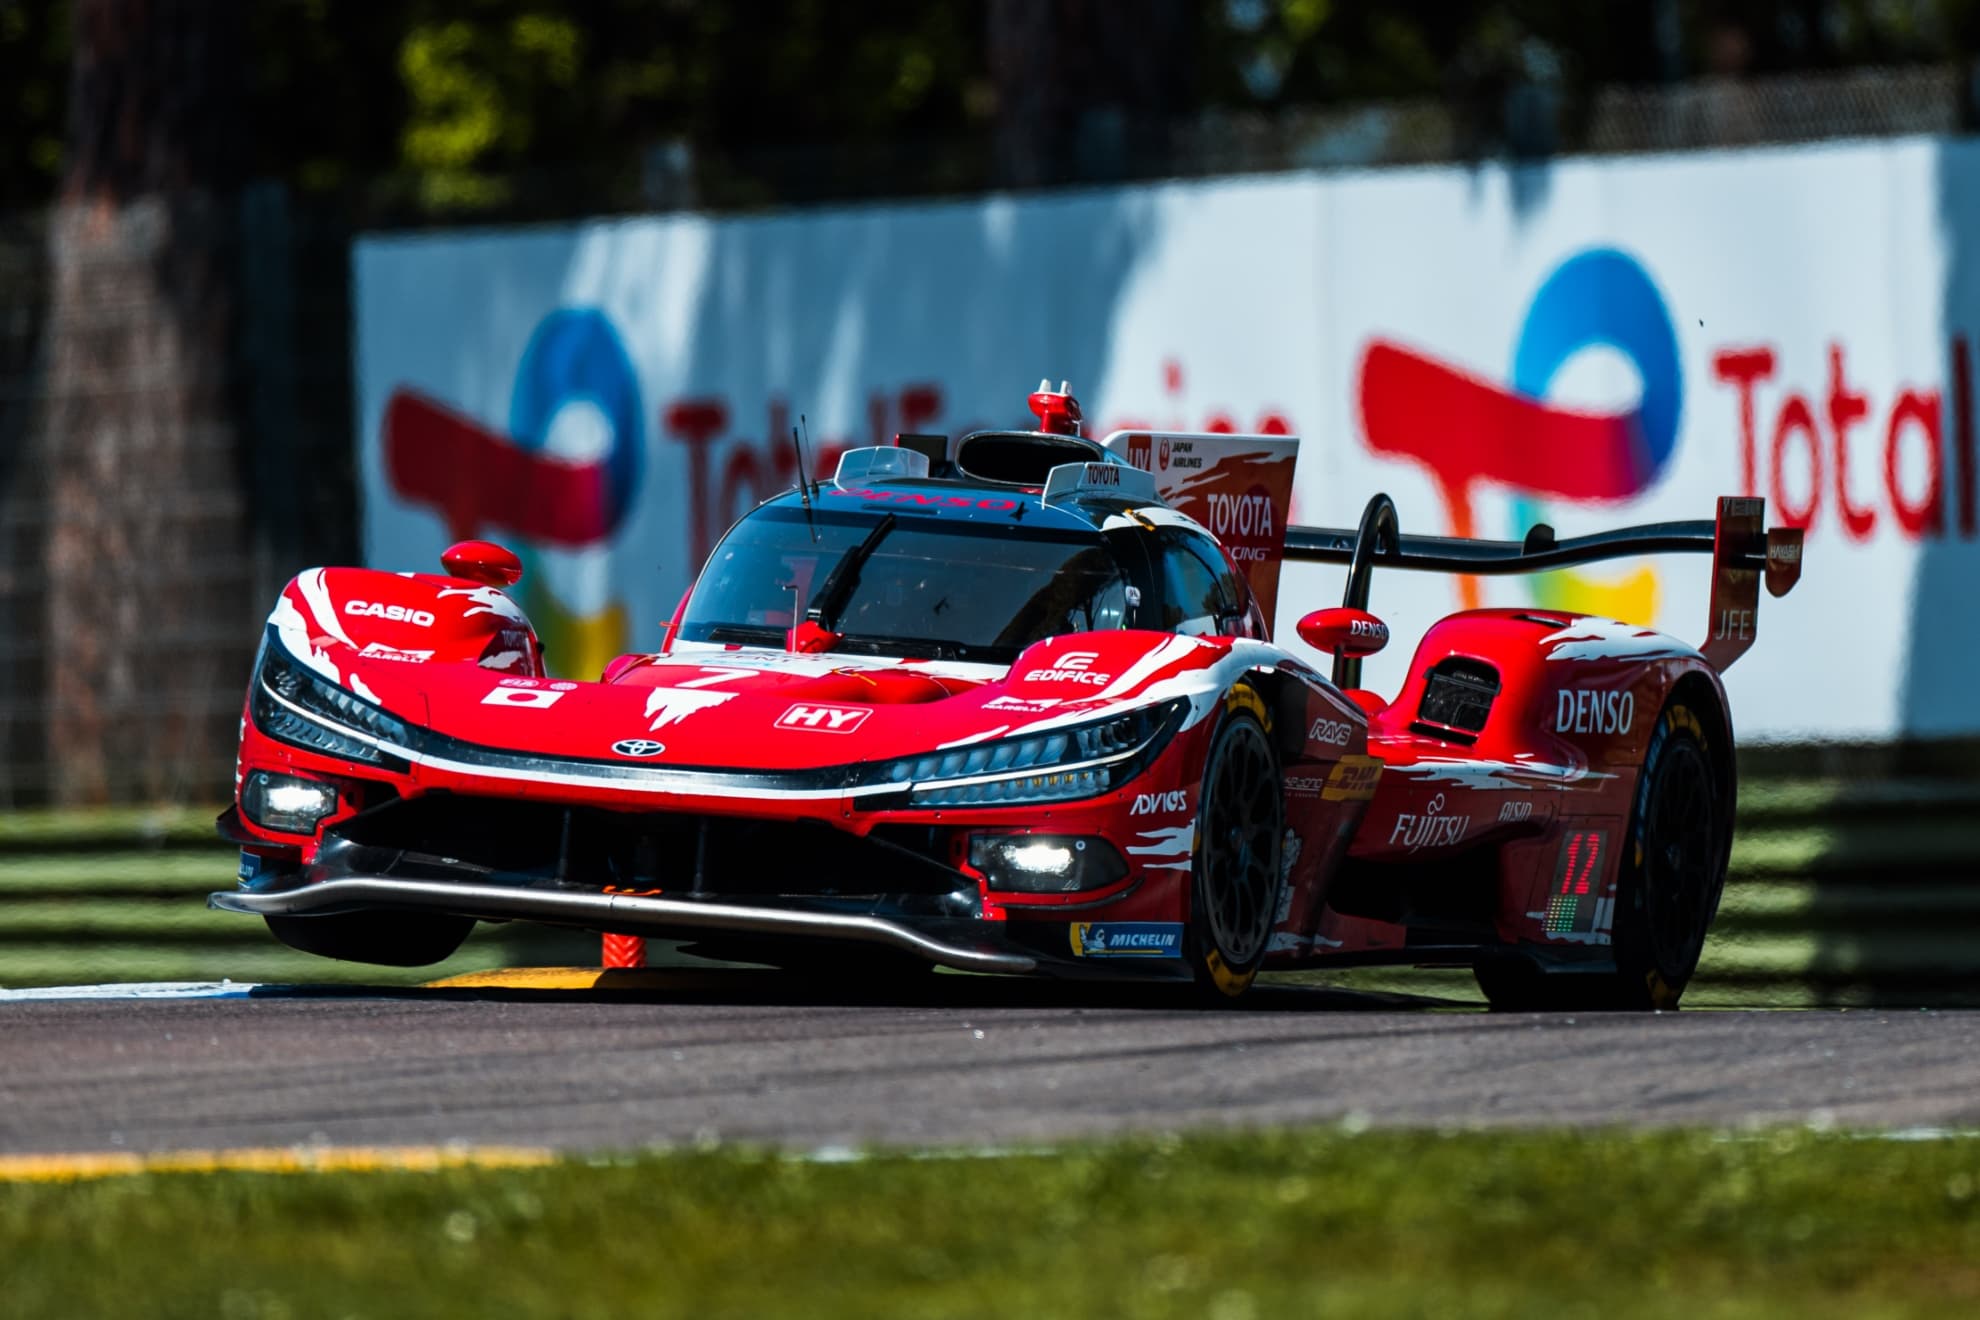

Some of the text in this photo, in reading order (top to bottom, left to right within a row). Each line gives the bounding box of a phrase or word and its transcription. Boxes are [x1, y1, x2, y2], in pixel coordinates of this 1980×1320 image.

[1172, 442, 1193, 453] JAPAN
[1172, 457, 1202, 468] AIRLINES
[1088, 465, 1120, 486] TOYOTA
[827, 487, 1017, 511] DENSO
[1208, 493, 1273, 537] TOYOTA
[1226, 545, 1271, 561] CING
[344, 599, 436, 628] CASIO
[1715, 609, 1751, 641] JFE
[1023, 669, 1111, 686] EDIFICE
[782, 706, 862, 729] HY
[1556, 689, 1634, 735] DENSO
[1308, 718, 1352, 746] RAYS
[1498, 802, 1533, 822] AISIN
[1388, 814, 1470, 855] FUJITSU
[1561, 833, 1600, 894] 12
[1110, 933, 1176, 947] MICHELIN
